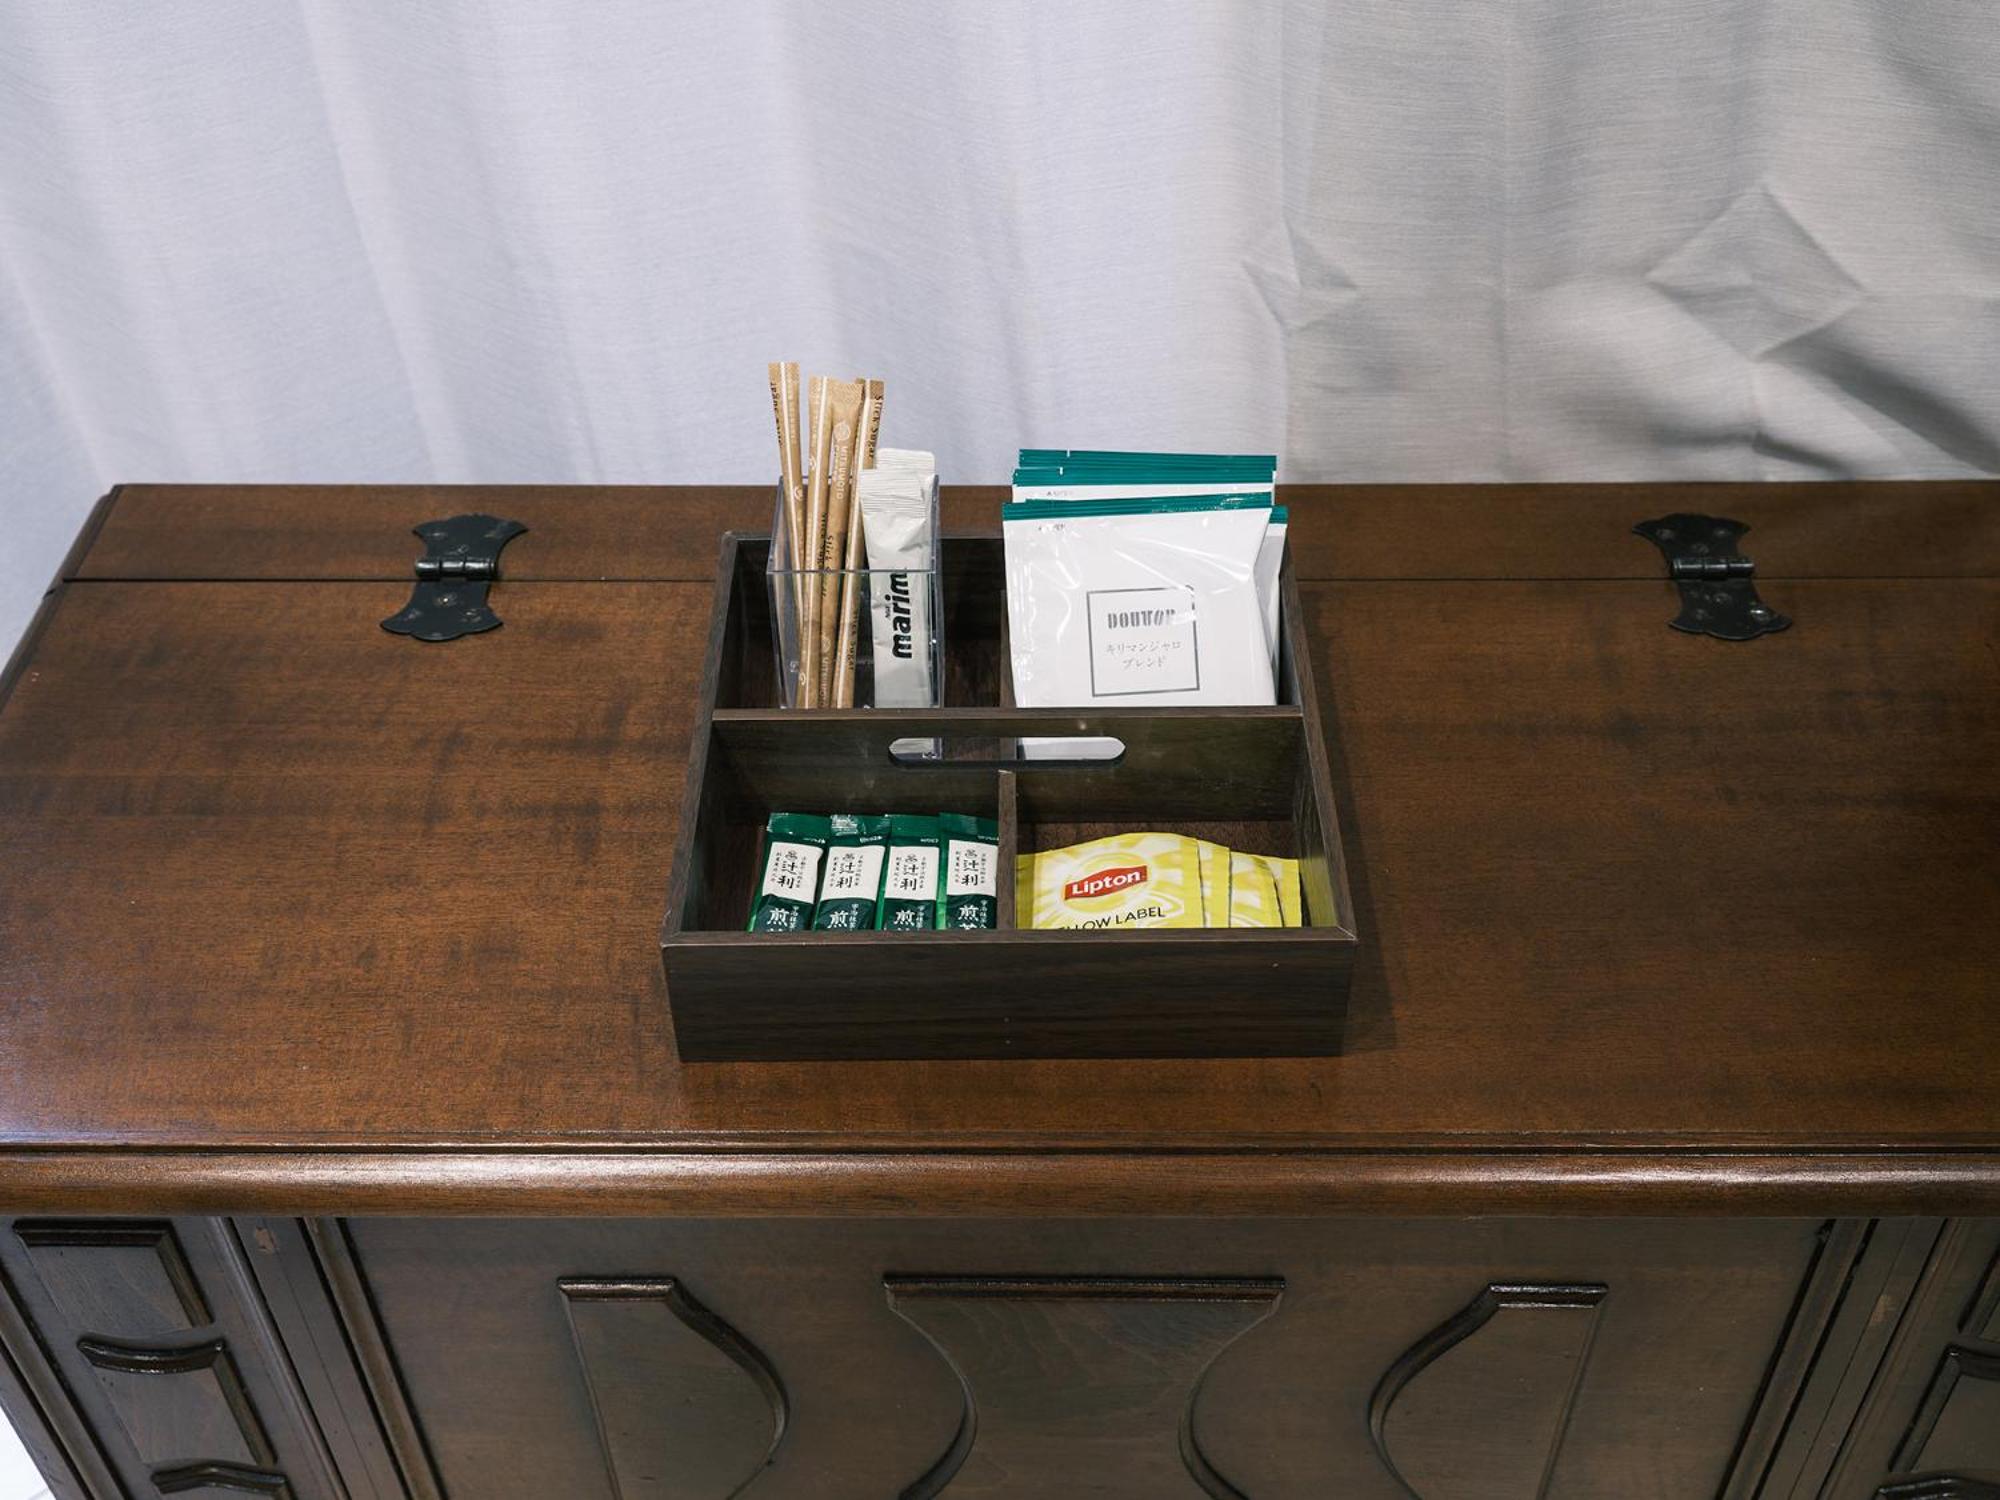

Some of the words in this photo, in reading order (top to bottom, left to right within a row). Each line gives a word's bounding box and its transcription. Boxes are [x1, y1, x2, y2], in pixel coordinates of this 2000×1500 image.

[885, 567, 913, 659] marim
[1107, 640, 1182, 655] キリマンジャロ
[1122, 655, 1167, 669] ブレンド
[1071, 871, 1141, 895] Lipton
[767, 907, 790, 931] 煎
[893, 909, 916, 931] 煎
[1115, 906, 1166, 925] LABEL
